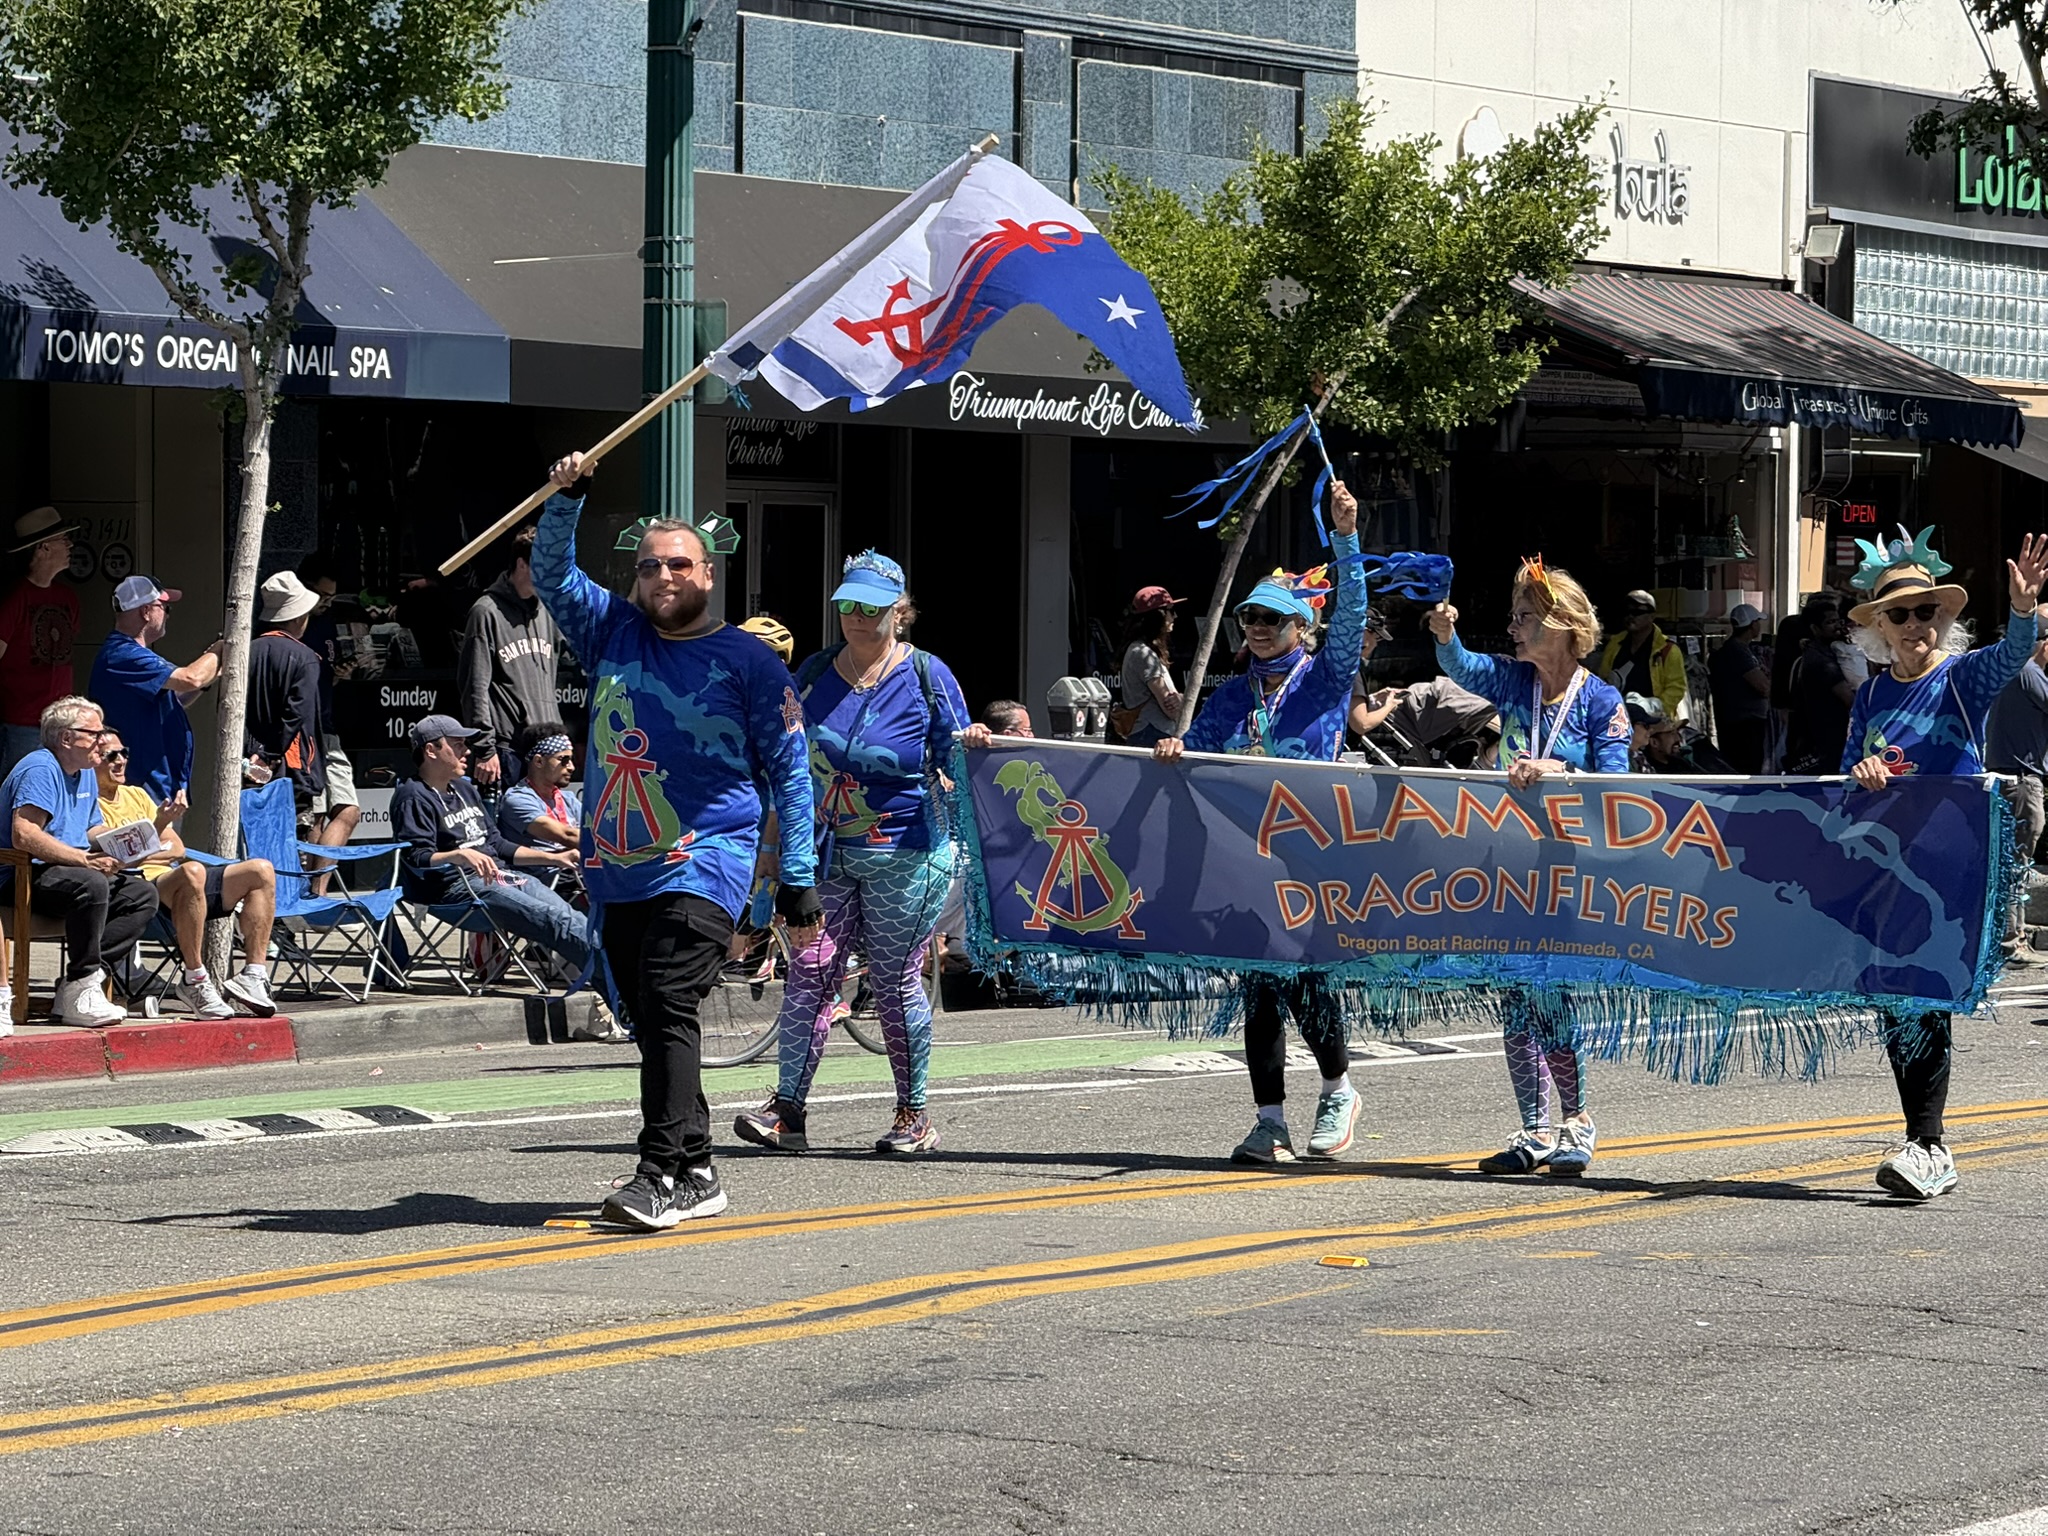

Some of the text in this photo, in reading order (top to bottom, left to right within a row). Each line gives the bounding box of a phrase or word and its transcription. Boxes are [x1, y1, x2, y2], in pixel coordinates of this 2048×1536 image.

[1959, 125, 2048, 211] Lola
[45, 328, 392, 379] TOMO'S ORGA NAIL SPA
[950, 371, 1204, 436] Triumphant Life Chuh
[1742, 382, 1785, 411] Global
[1785, 386, 1847, 415] Treasures
[1858, 395, 1897, 431] Unique
[1900, 399, 1929, 427] Gifts
[727, 435, 784, 465] Church
[1843, 504, 1876, 523] OPEN
[99, 518, 129, 541] 1411
[499, 642, 520, 663] SAN
[380, 685, 437, 711] Sunday
[386, 717, 404, 738] 10
[1257, 779, 1733, 871] ALAMEDA
[1274, 865, 1738, 948] DRAGONFLYERS
[1337, 932, 1655, 960] Dragon Boat Racing in Alameda, CA
